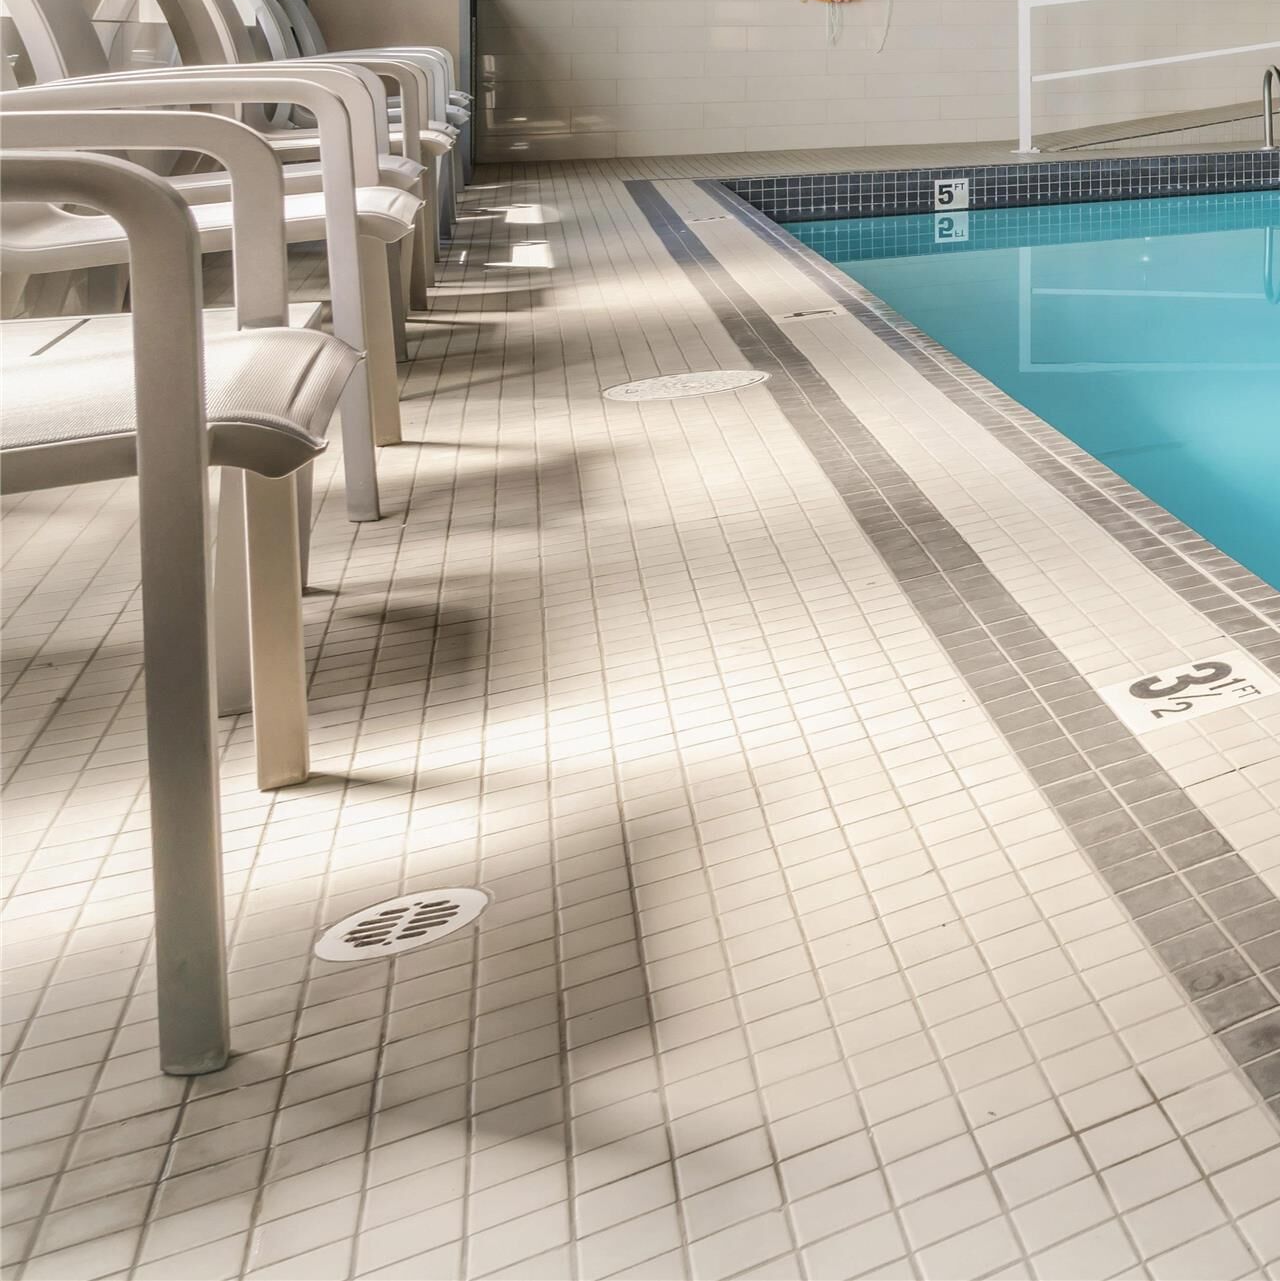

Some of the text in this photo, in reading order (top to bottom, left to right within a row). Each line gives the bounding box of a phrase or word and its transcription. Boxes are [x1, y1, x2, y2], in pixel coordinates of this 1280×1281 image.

[938, 182, 965, 205] 5 FT
[1129, 661, 1233, 699] 3
[1231, 684, 1262, 699] FT
